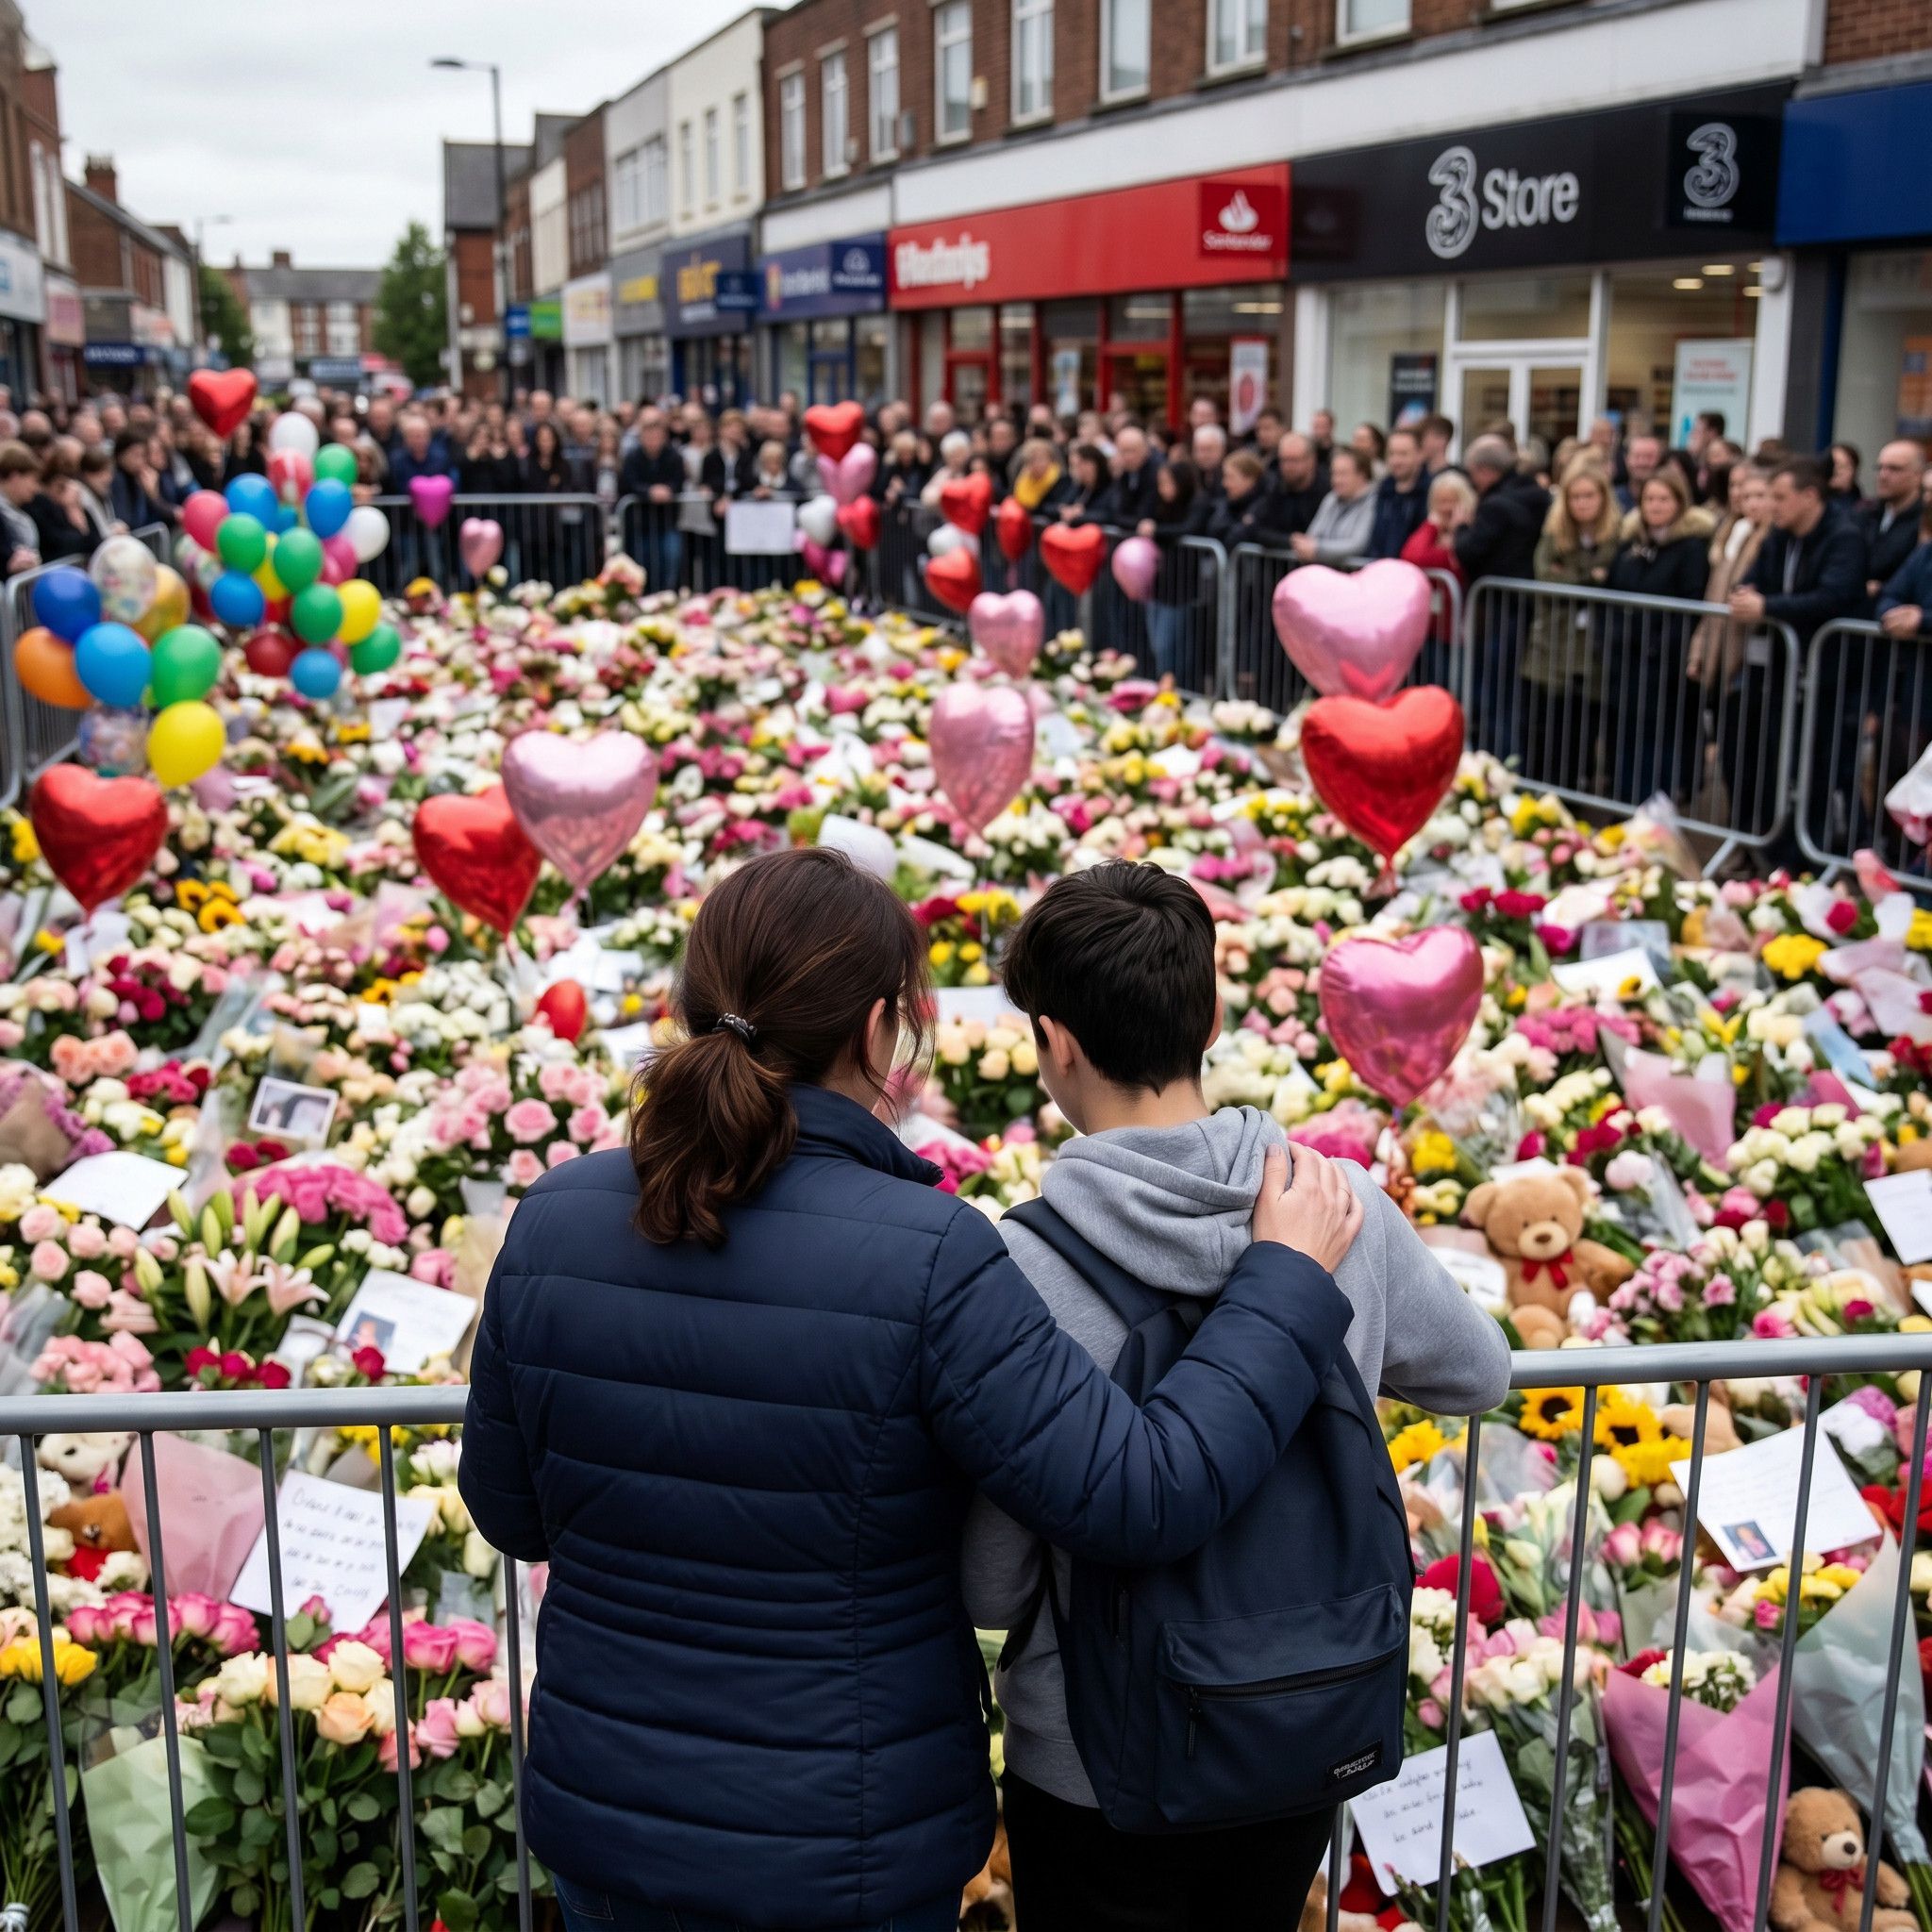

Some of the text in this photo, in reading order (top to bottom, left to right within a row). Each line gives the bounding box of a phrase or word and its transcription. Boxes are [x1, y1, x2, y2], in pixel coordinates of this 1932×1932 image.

[1425, 145, 1580, 259] 3 Store
[1683, 122, 1740, 208] 3
